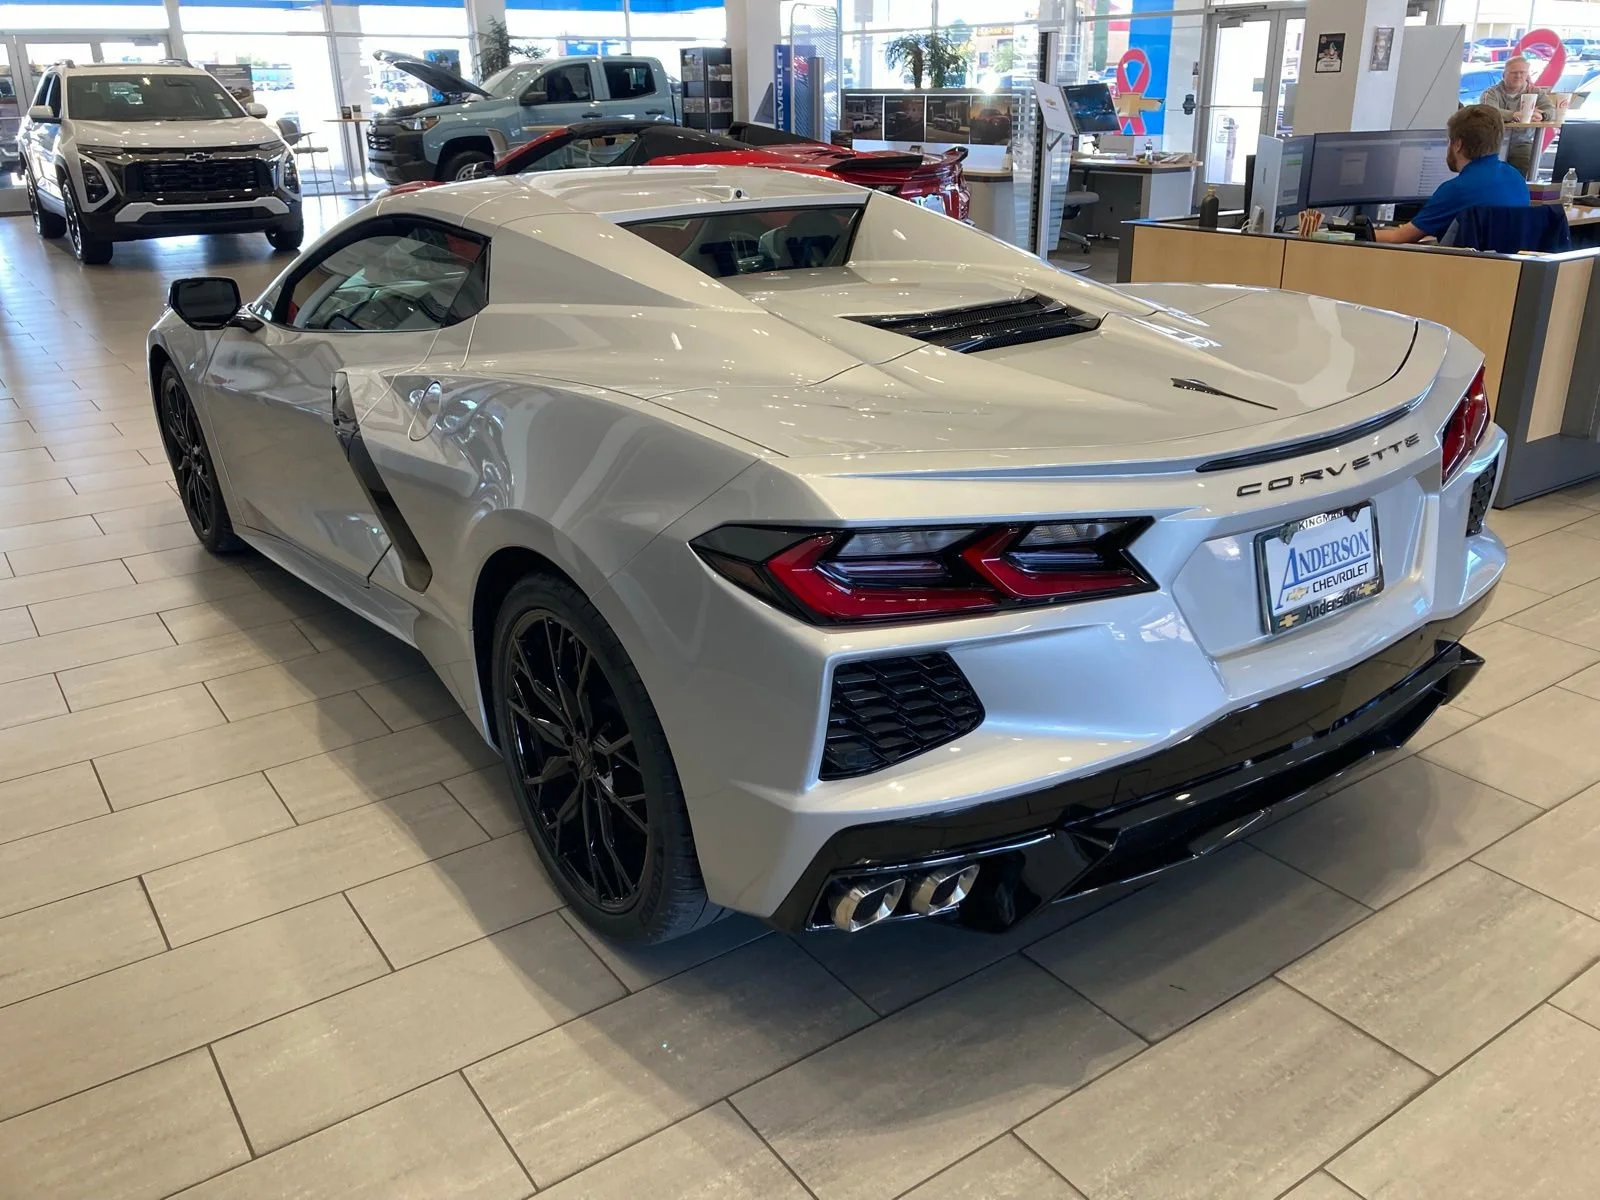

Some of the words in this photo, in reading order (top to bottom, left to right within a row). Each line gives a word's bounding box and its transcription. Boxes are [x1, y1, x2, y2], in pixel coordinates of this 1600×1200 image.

[776, 48, 785, 132] HEVROLET
[1236, 433, 1421, 497] CORVETTE
[1299, 509, 1345, 531] KINGMAN
[1275, 529, 1371, 610] ANDERSON
[1312, 562, 1369, 593] CHEVROLET
[1304, 589, 1357, 621] Anderson
